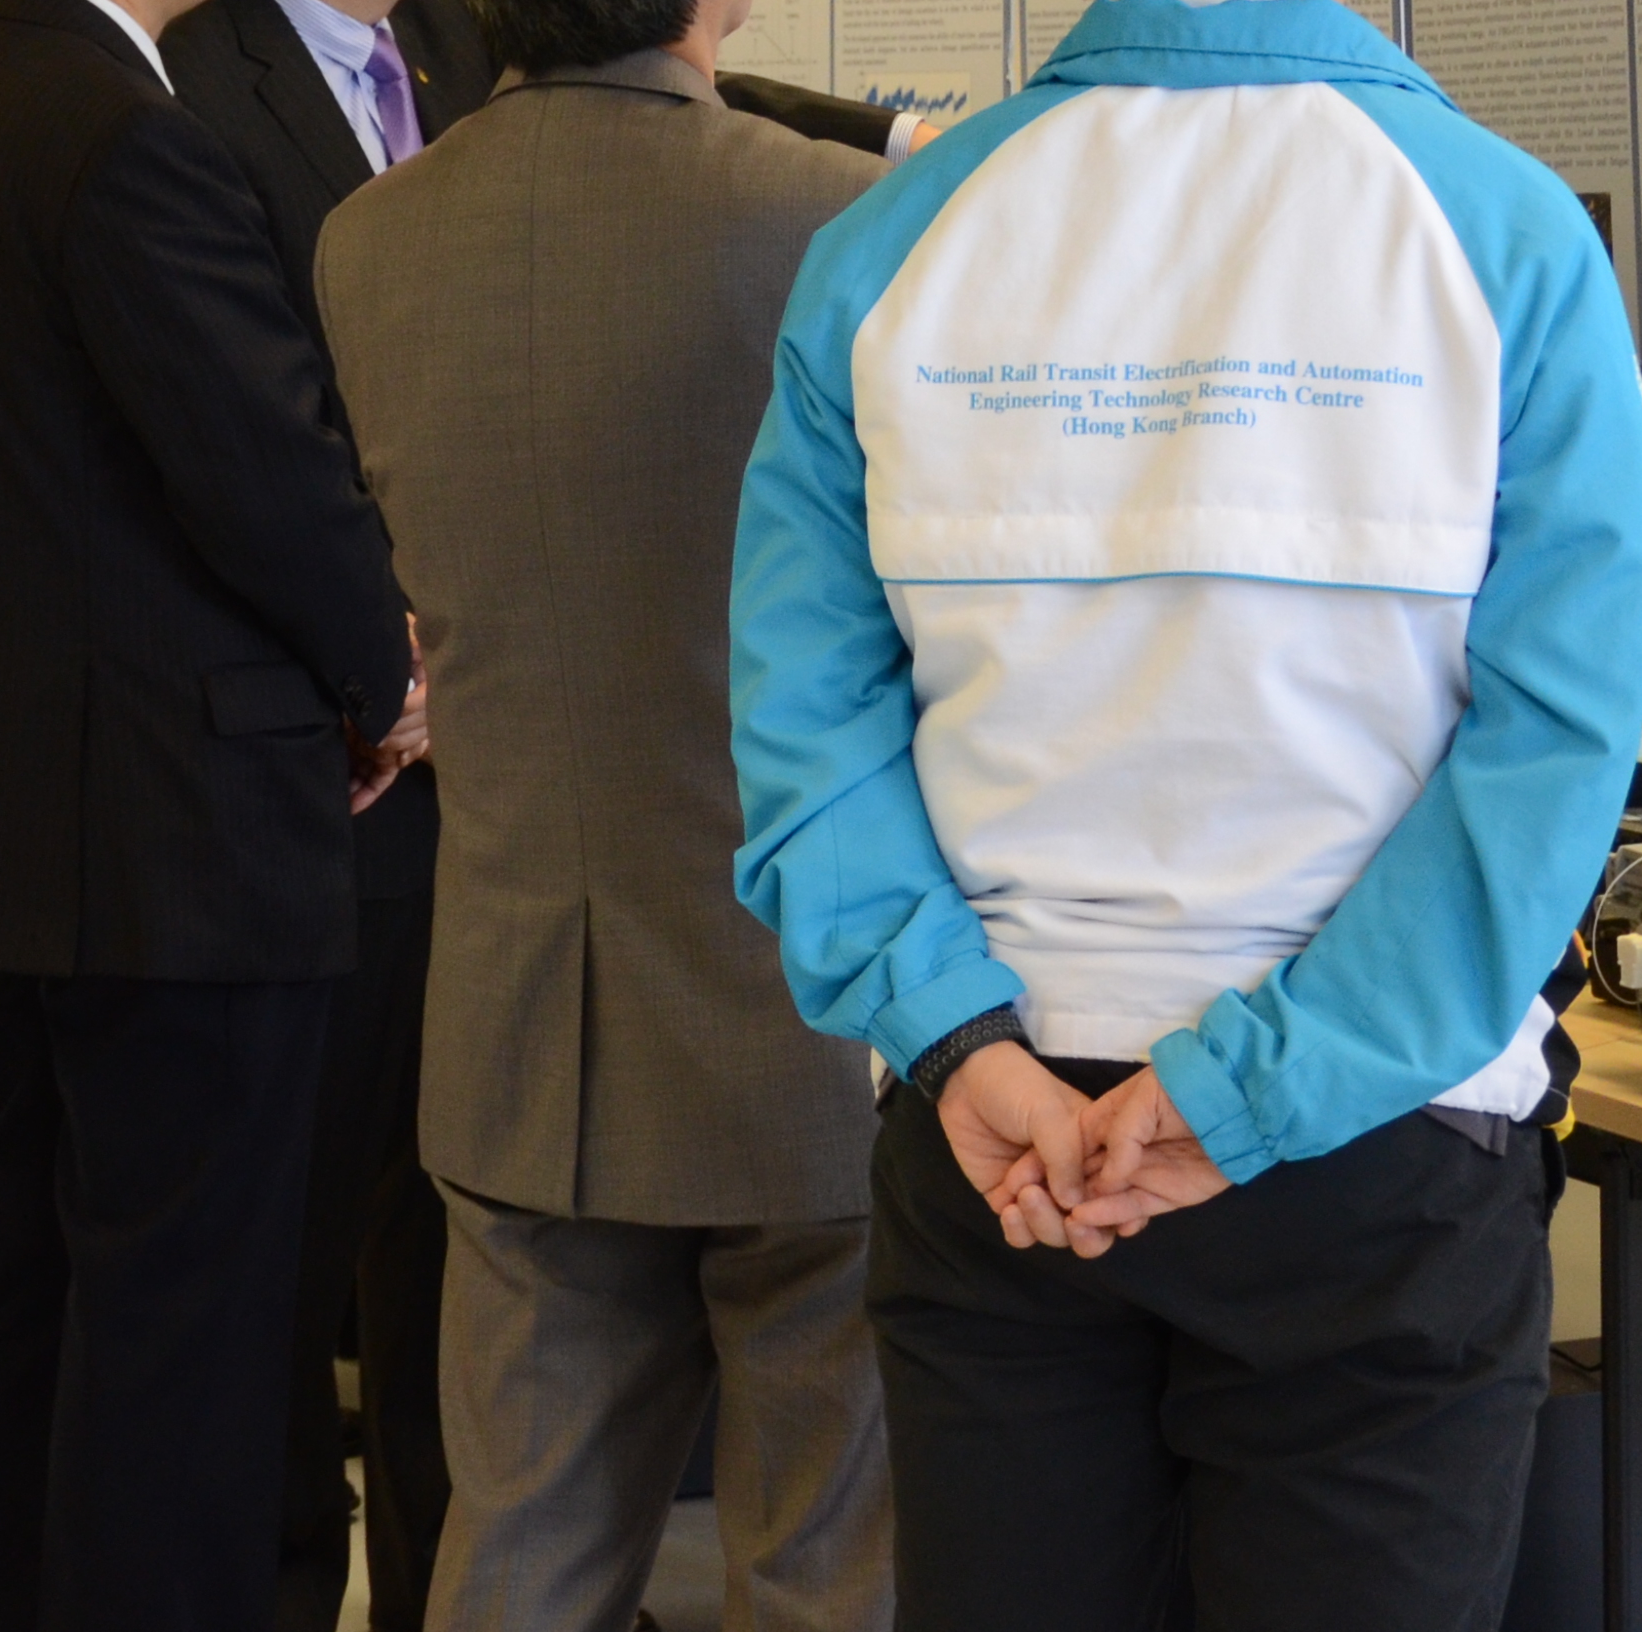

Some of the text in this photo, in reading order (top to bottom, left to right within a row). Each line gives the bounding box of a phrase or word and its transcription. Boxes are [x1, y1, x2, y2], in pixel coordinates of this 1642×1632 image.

[916, 356, 1424, 387] National Rail Transit Electrification and Automation
[969, 382, 1364, 413] Engineering Technology Research Centre
[1063, 408, 1257, 438] (Hong Kong Branch)
